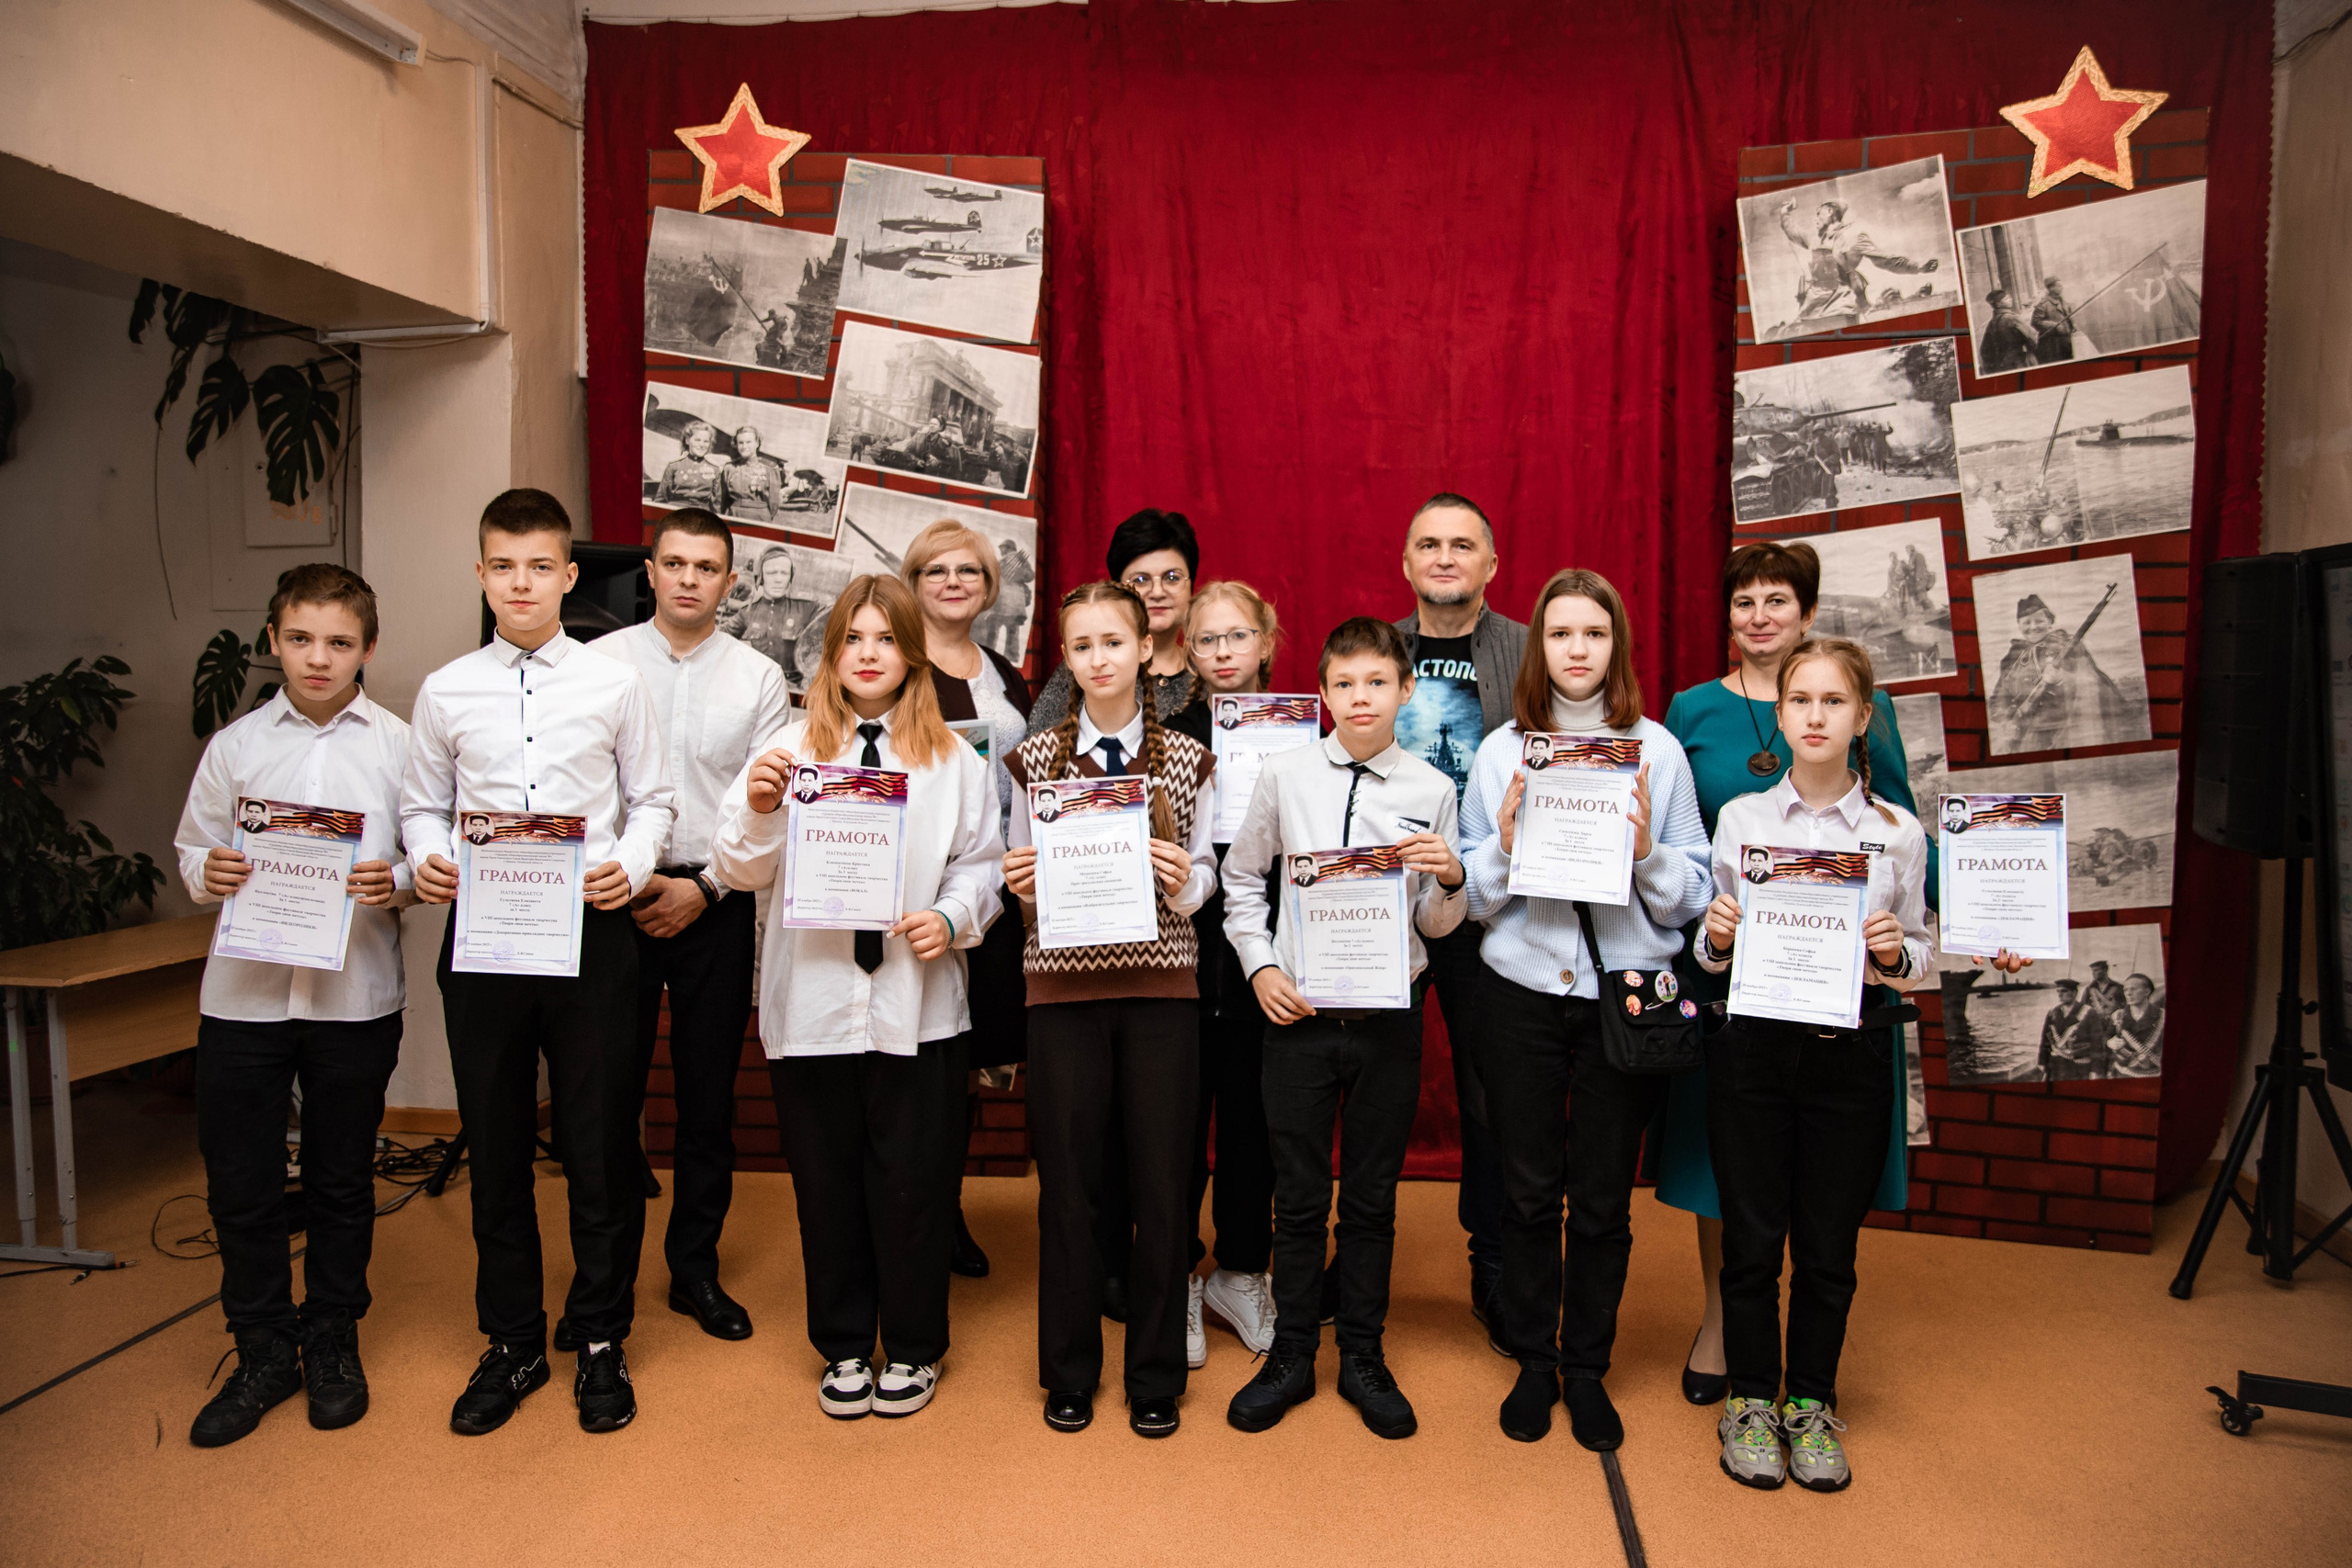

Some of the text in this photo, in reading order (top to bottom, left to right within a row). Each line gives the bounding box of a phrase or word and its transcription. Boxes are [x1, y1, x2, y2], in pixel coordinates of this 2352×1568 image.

[977, 254, 990, 266] 25
[1533, 795, 1621, 814] ГРАМОТА
[805, 829, 889, 845] ГРАМОТА
[1051, 840, 1133, 859] ГРАМОТА
[1862, 843, 1883, 852] Style
[249, 857, 341, 881] ГРАМОТА
[1957, 857, 2047, 872] ГРАМОТА
[479, 869, 565, 885] ГРАМОТА
[270, 881, 315, 891] НАГРАЖДАЕТСЯ
[1308, 906, 1391, 922] ГРАМОТА
[1755, 909, 1849, 931] ГРАМОТА
[1777, 933, 1823, 942] НАГРАЖДАЕТСЯ
